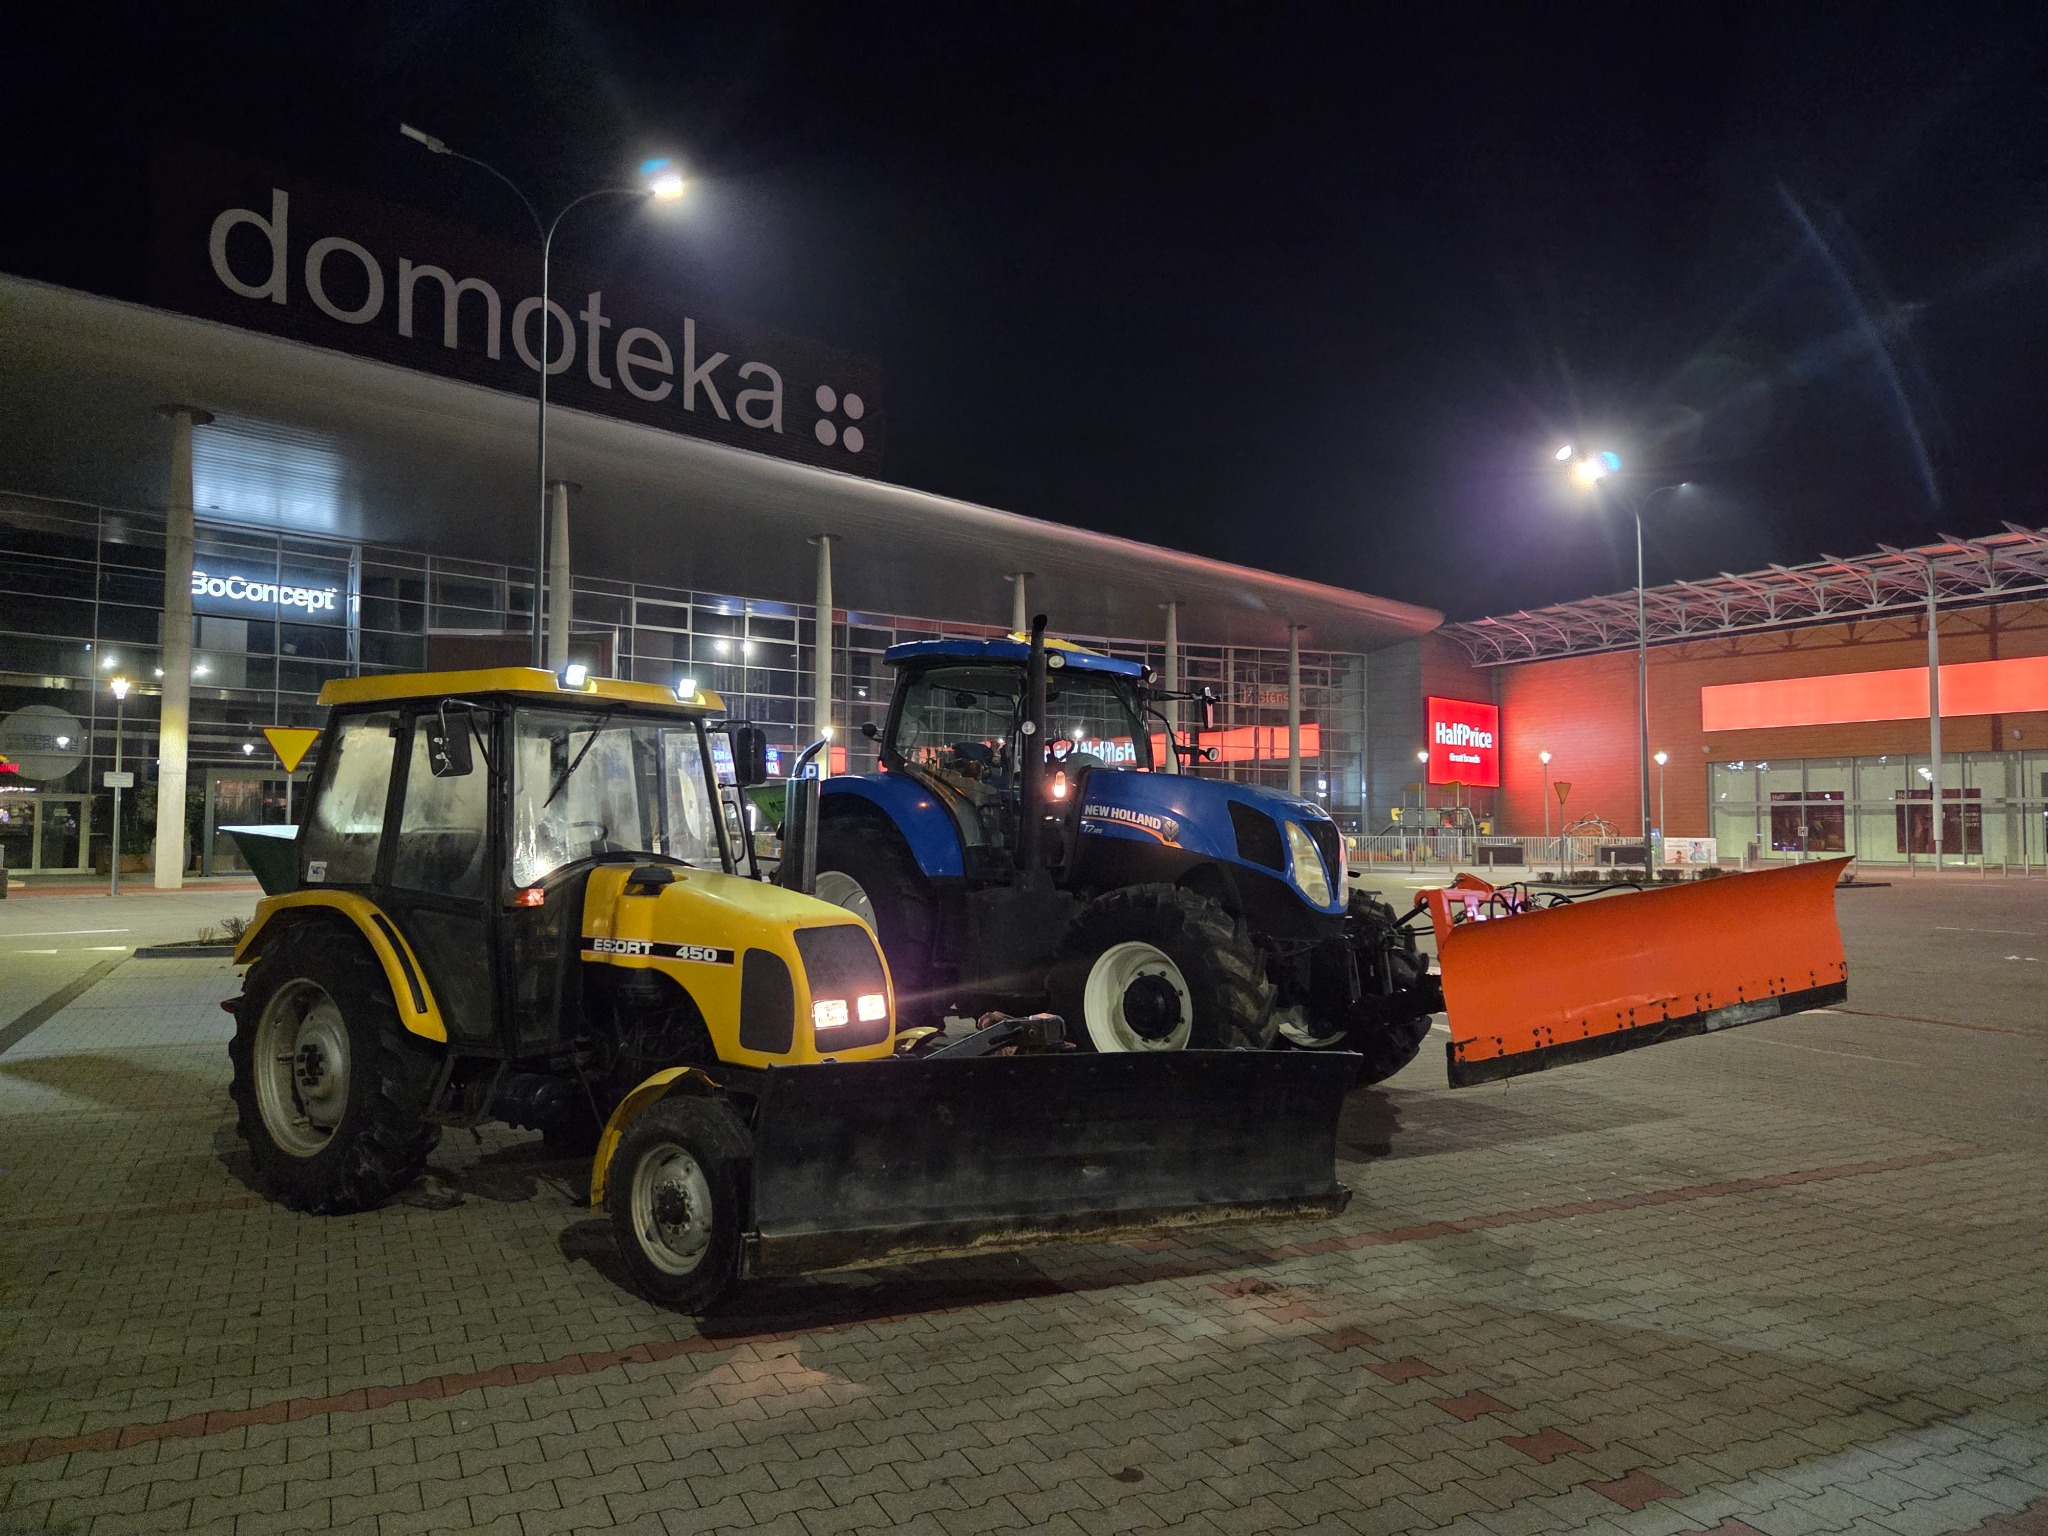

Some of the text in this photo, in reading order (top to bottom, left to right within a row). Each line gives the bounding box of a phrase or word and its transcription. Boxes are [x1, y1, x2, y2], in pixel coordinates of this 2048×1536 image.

[209, 188, 785, 434] domoteka
[191, 571, 335, 613] BoConcept
[1435, 721, 1493, 749] HalfPrice
[806, 764, 817, 779] P
[1084, 804, 1162, 830] NEW HOLLAND
[675, 945, 718, 962] 450
